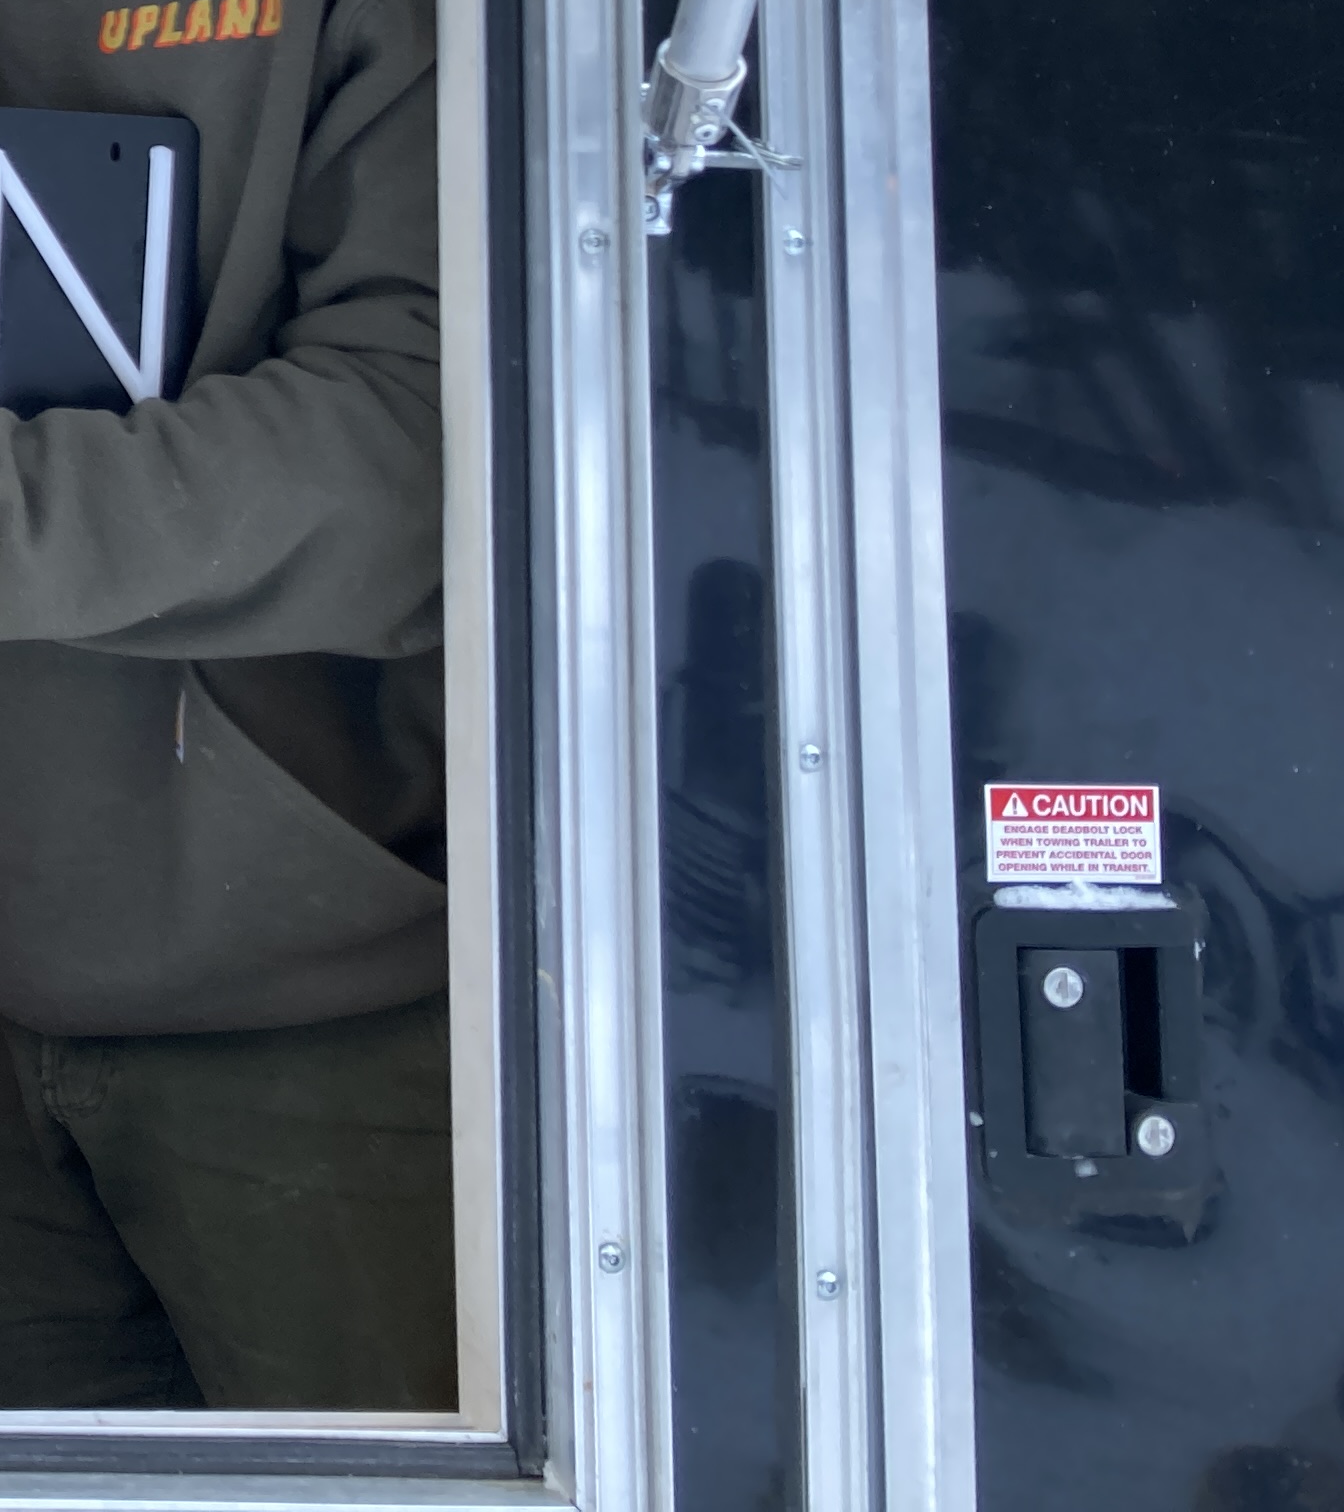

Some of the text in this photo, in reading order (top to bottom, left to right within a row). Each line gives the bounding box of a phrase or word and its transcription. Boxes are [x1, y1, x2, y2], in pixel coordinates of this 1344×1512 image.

[1032, 793, 1149, 817] CAUTION
[1004, 825, 1143, 834] ENGAGE DEADBOLT LOCK
[1000, 838, 1147, 847] WHEN TOWING TRAILER TO
[996, 850, 1152, 860] PREVENT ACCIDENTAL DOOR
[998, 863, 1047, 871] OPENING
[1050, 863, 1084, 871] WHILE
[1088, 863, 1099, 871] IN
